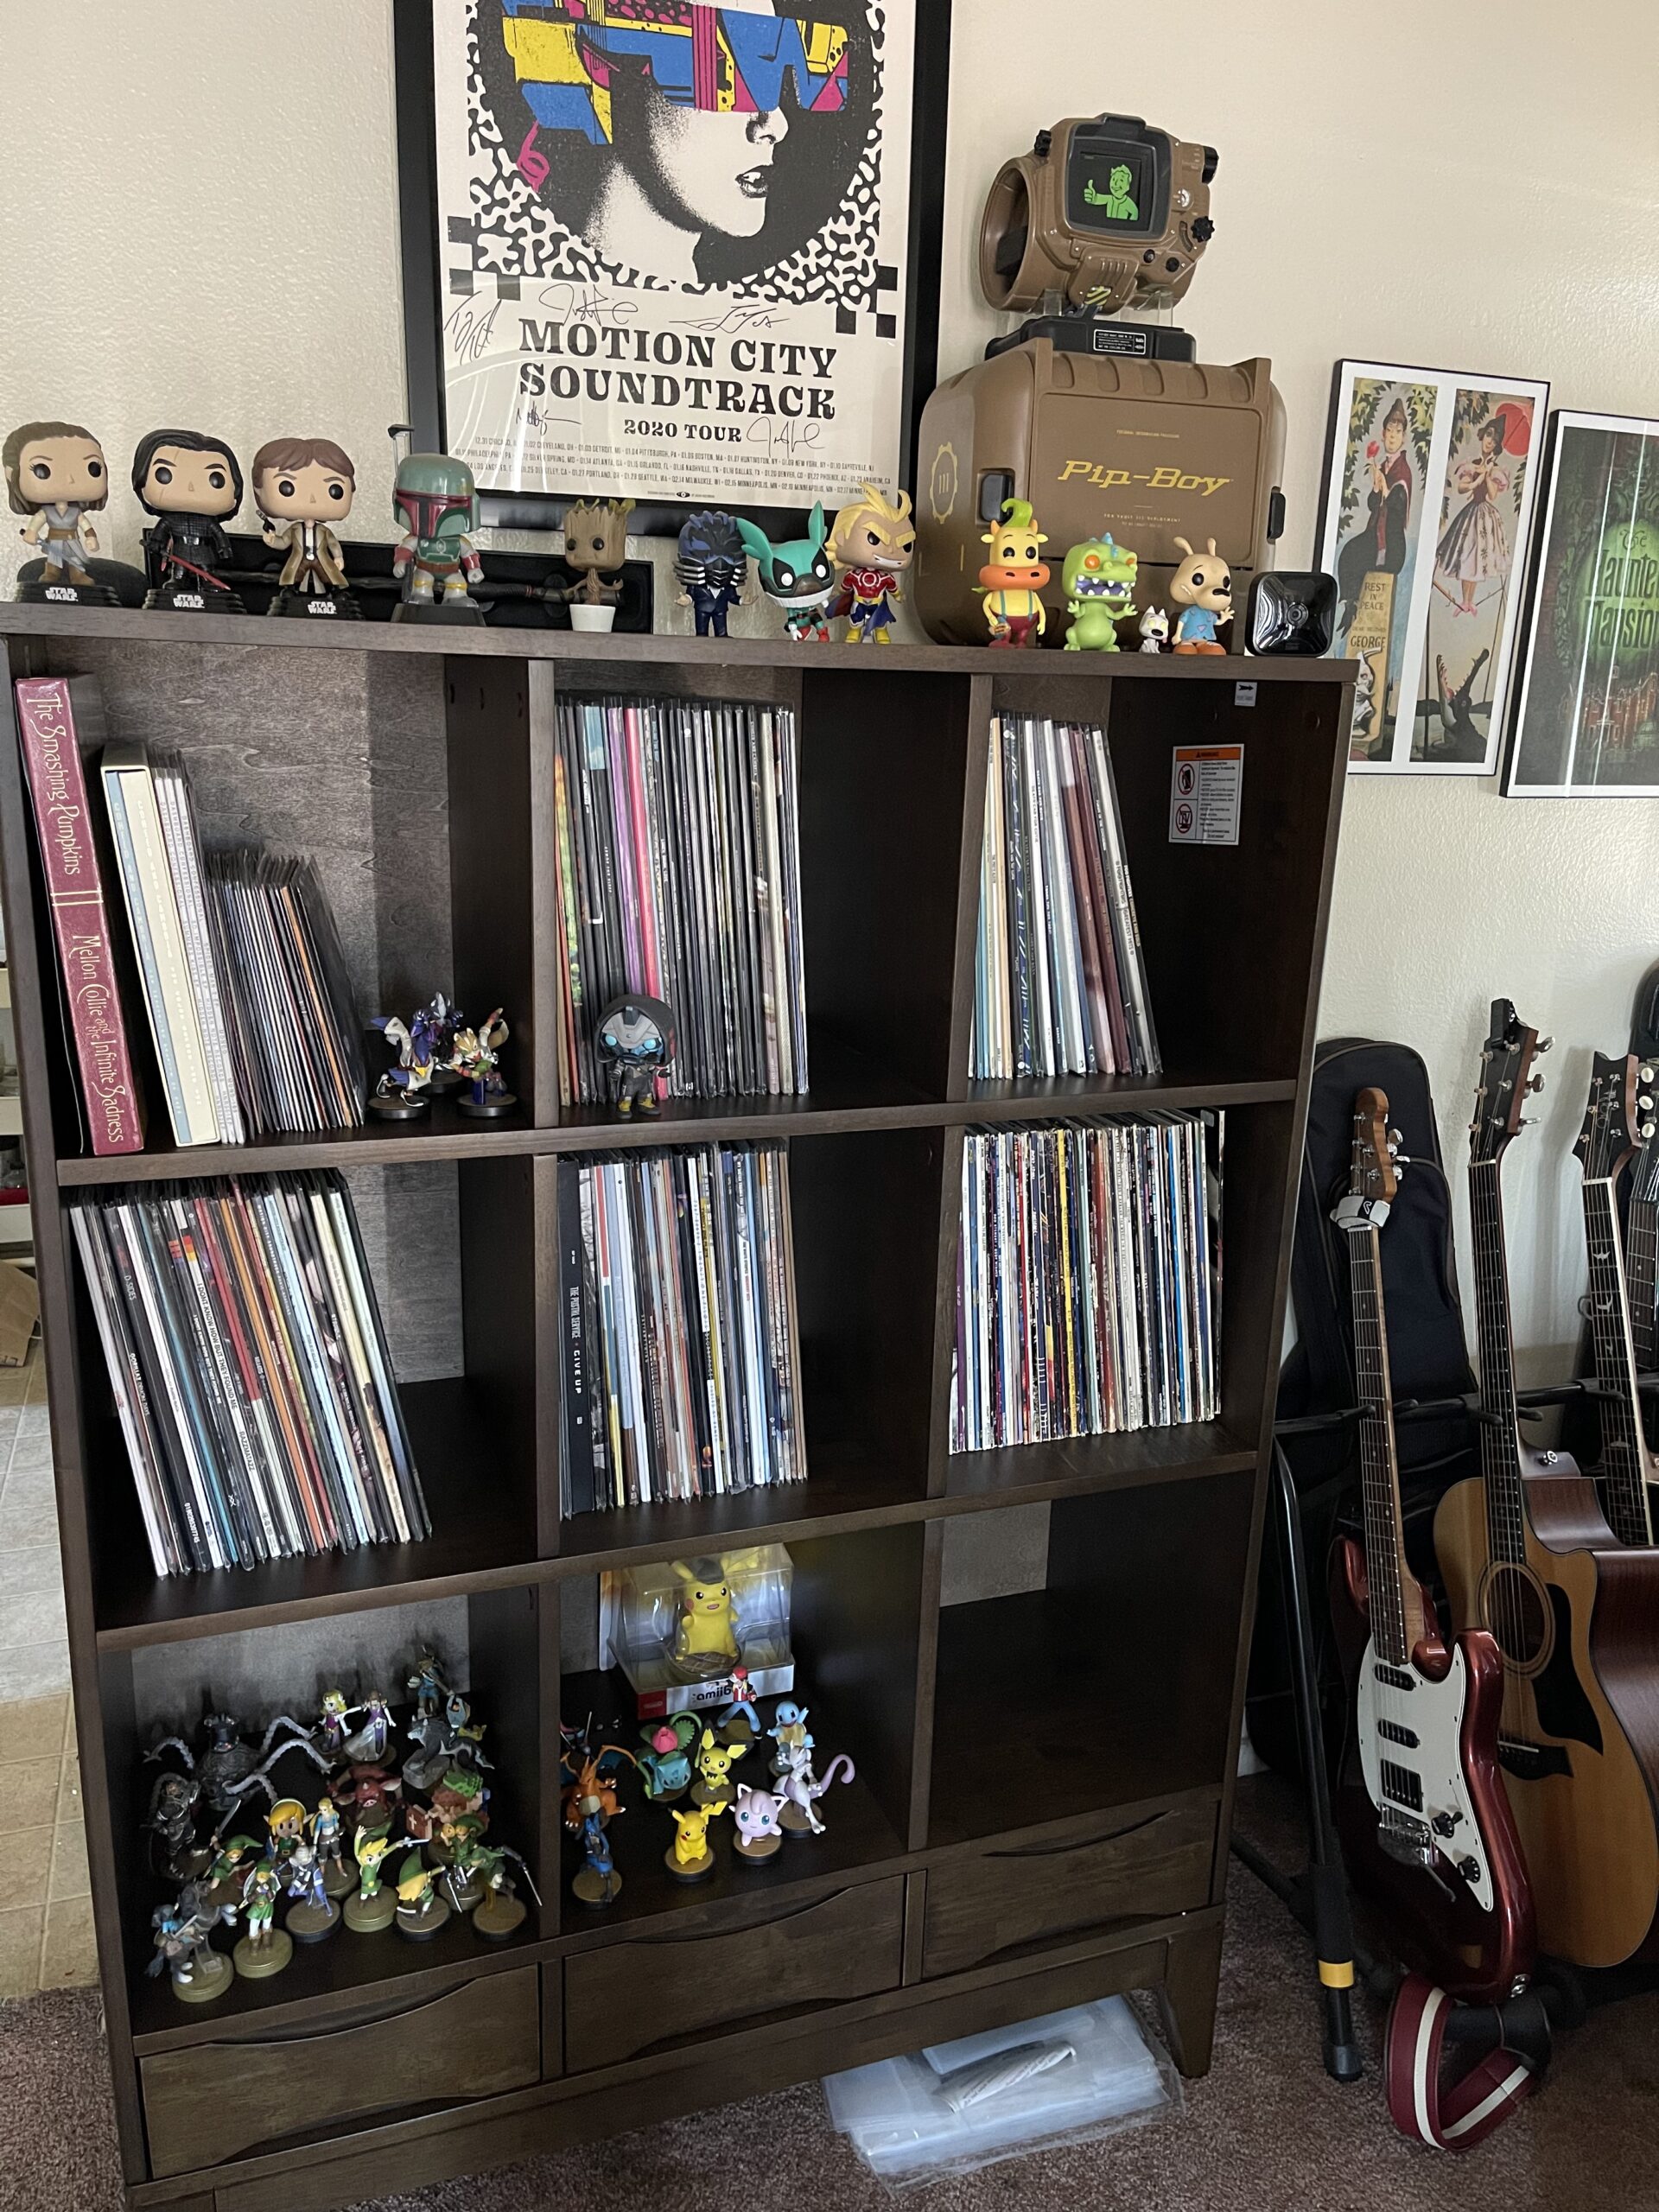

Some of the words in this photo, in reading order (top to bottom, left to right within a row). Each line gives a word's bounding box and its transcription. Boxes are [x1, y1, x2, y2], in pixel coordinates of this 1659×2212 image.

[518, 318, 715, 368] MOTION
[730, 339, 837, 378] CITY
[519, 362, 836, 420] SOUNDTRACK
[624, 419, 677, 438] 2020
[684, 424, 741, 442] TOUR
[1057, 461, 1230, 497] Pip-Boy
[1586, 549, 1659, 599] Haunte
[1365, 582, 1386, 591] REST
[45, 592, 79, 602] WARS
[173, 599, 205, 608] WARS
[1360, 601, 1384, 610] PEACE
[308, 605, 337, 614] WARS
[1351, 635, 1386, 648] GEORGE
[27, 692, 65, 723] The
[30, 715, 77, 803] Smashing
[47, 801, 86, 877] Pumpkins
[67, 932, 106, 982] Mellon
[74, 982, 112, 1020] Collie
[85, 1026, 102, 1042] the
[93, 1017, 114, 1037] and
[91, 1039, 124, 1086] Infinite
[92, 1077, 130, 1144] Sadness
[124, 1274, 137, 1301] D-SIDES
[198, 1287, 207, 1305] DONT
[570, 1287, 579, 1296] THE
[203, 1306, 213, 1326] KNOW
[570, 1297, 580, 1317] POSTAL
[209, 1327, 219, 1344] HOW
[571, 1317, 581, 1338] SERVICE
[214, 1344, 223, 1357] BUT
[219, 1358, 228, 1376] THEY
[223, 1376, 235, 1399] FOUND
[575, 1379, 582, 1394] UP
[230, 1399, 238, 1410] ME
[238, 1431, 256, 1472] RAZZMATAZZ
[696, 1685, 734, 1700] amiib
